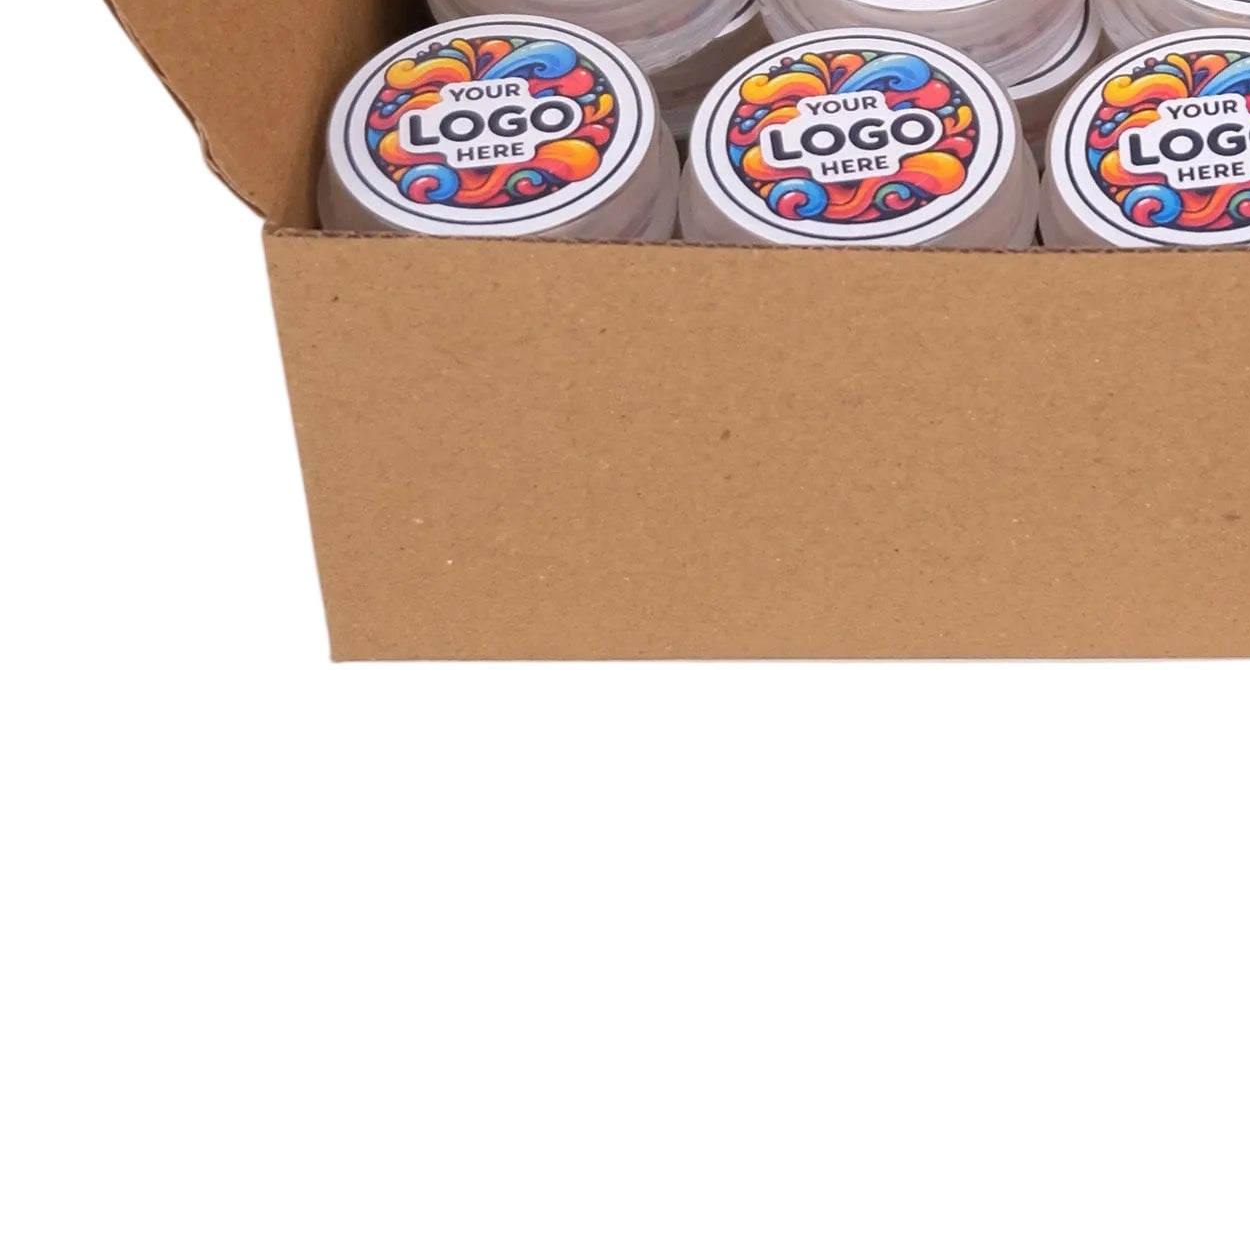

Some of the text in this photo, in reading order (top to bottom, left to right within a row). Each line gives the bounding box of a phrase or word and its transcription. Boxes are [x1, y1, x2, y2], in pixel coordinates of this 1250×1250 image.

[449, 83, 520, 102] YOUR
[806, 95, 878, 116] YOUR
[1166, 99, 1238, 120] YOUR
[409, 101, 575, 147] LOGO
[769, 113, 935, 161] LOGO
[457, 142, 524, 162] HERE
[821, 155, 889, 176] HERE
[1178, 161, 1245, 183] HERE
